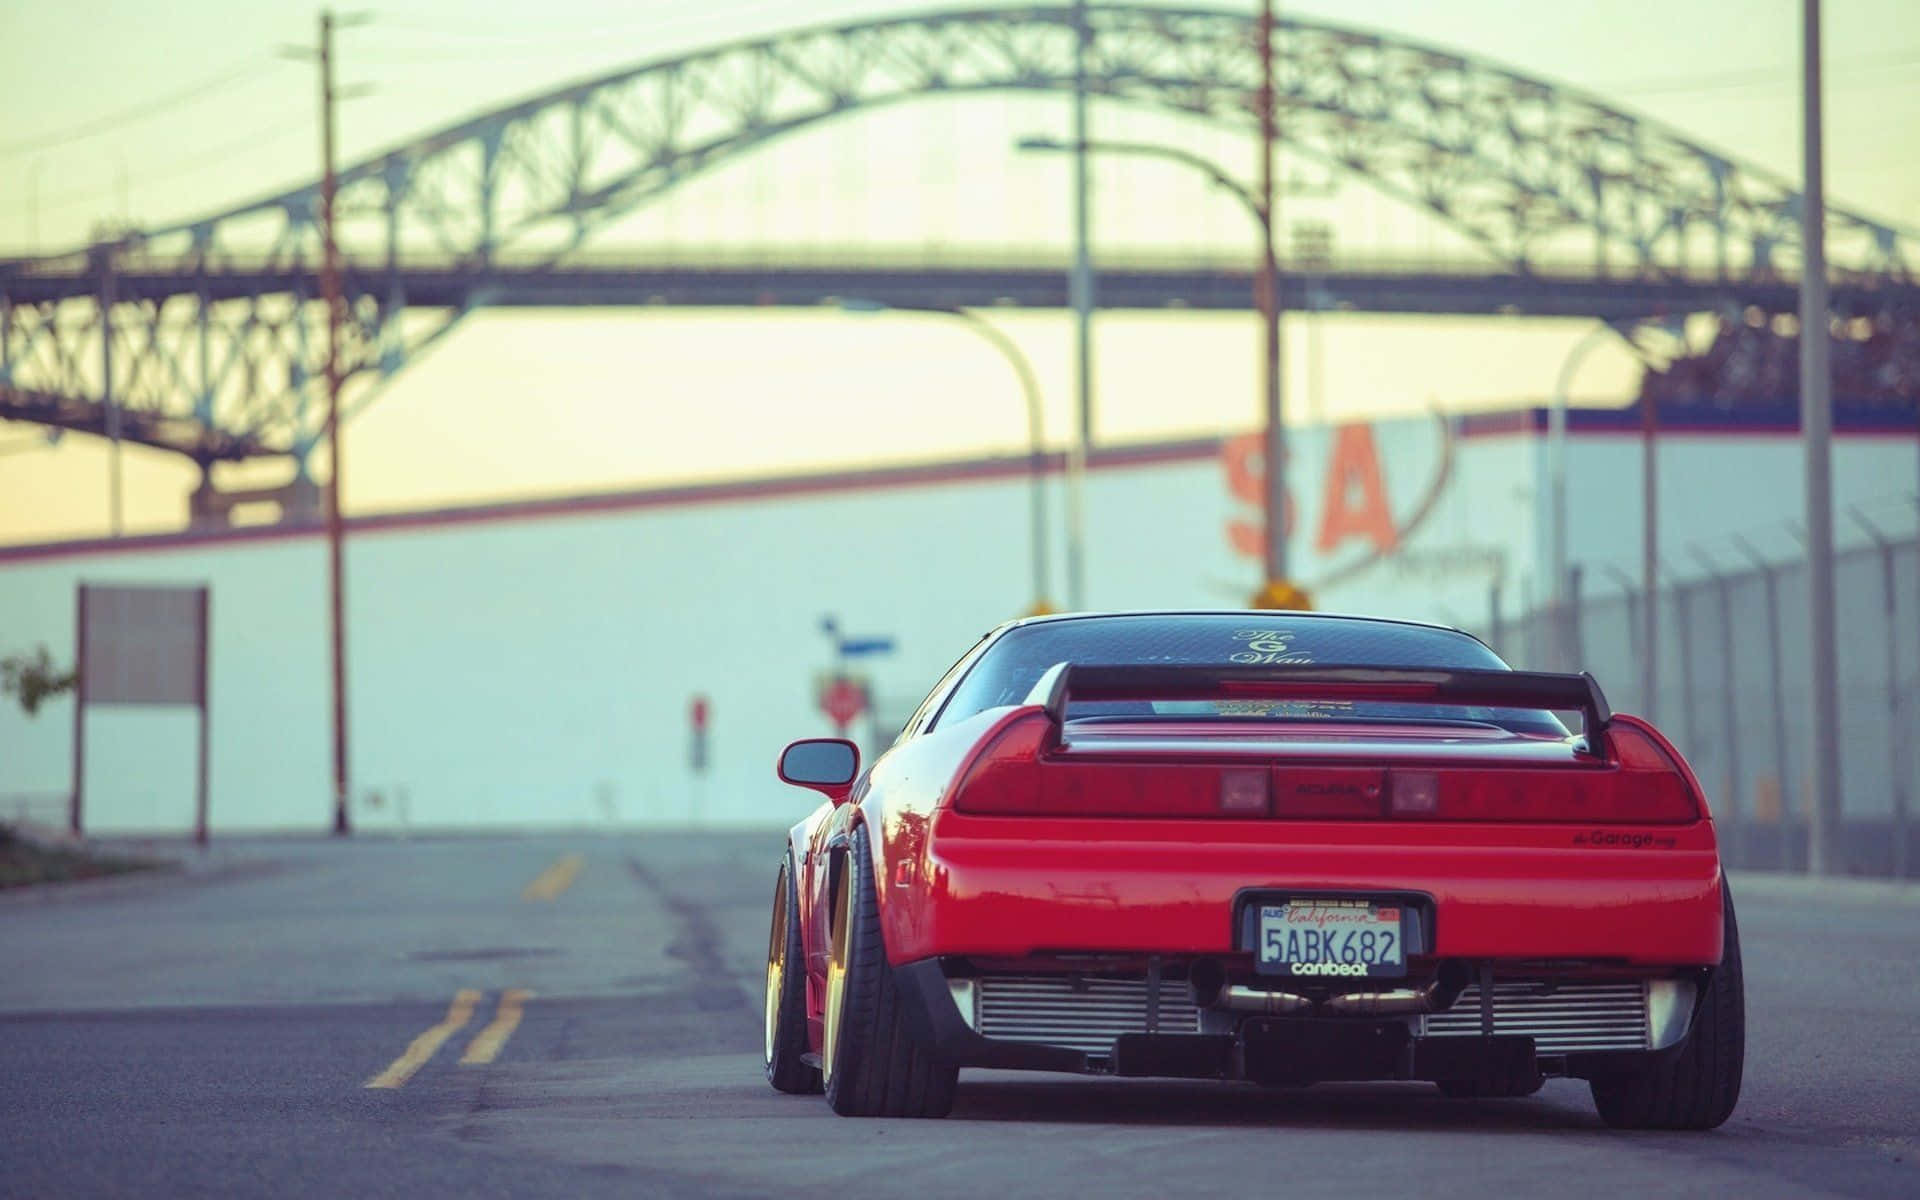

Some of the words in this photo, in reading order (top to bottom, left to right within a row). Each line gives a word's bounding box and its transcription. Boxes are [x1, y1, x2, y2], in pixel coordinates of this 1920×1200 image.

[1248, 640, 1288, 652] G
[1590, 830, 1653, 848] Garage
[1286, 906, 1372, 928] California
[1266, 928, 1396, 965] 5ABK682
